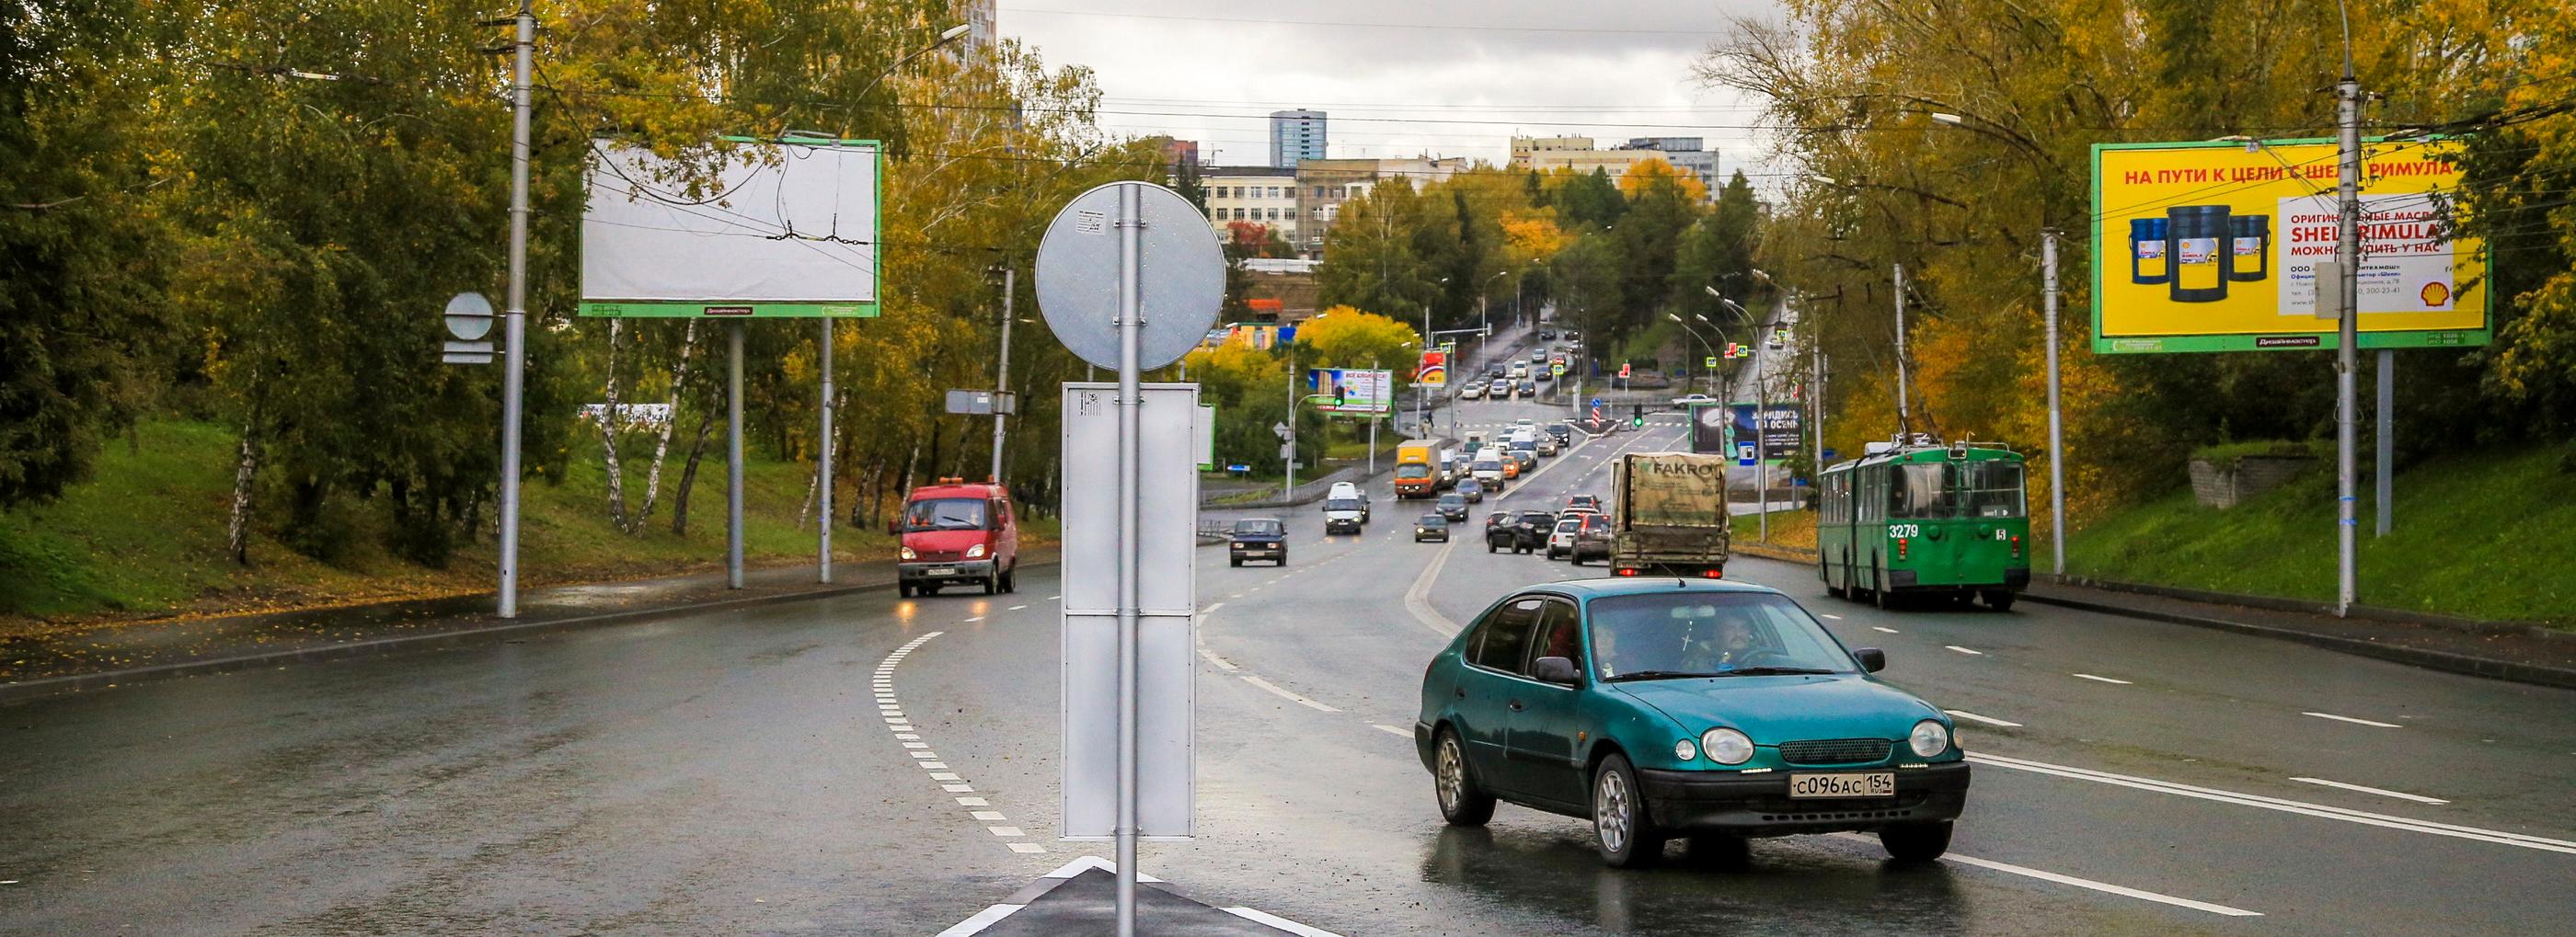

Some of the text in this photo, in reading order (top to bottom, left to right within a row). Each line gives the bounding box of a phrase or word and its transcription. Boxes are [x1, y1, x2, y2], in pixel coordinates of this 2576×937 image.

[2125, 171, 2152, 184] НА
[2157, 169, 2206, 184] ПУТИ
[2214, 168, 2225, 181] К
[2232, 166, 2283, 183] ЦЕЛИ
[2289, 165, 2299, 179] С
[2370, 161, 2454, 177] РИМУЛА
[2291, 225, 2340, 243] SHEL
[2357, 244, 2398, 255] УПИТЬ
[2402, 244, 2409, 253] У
[2415, 243, 2440, 253] НАС
[1654, 463, 1713, 476] FAKRO
[1889, 524, 1918, 538] 3279
[1867, 775, 1892, 788] 154
